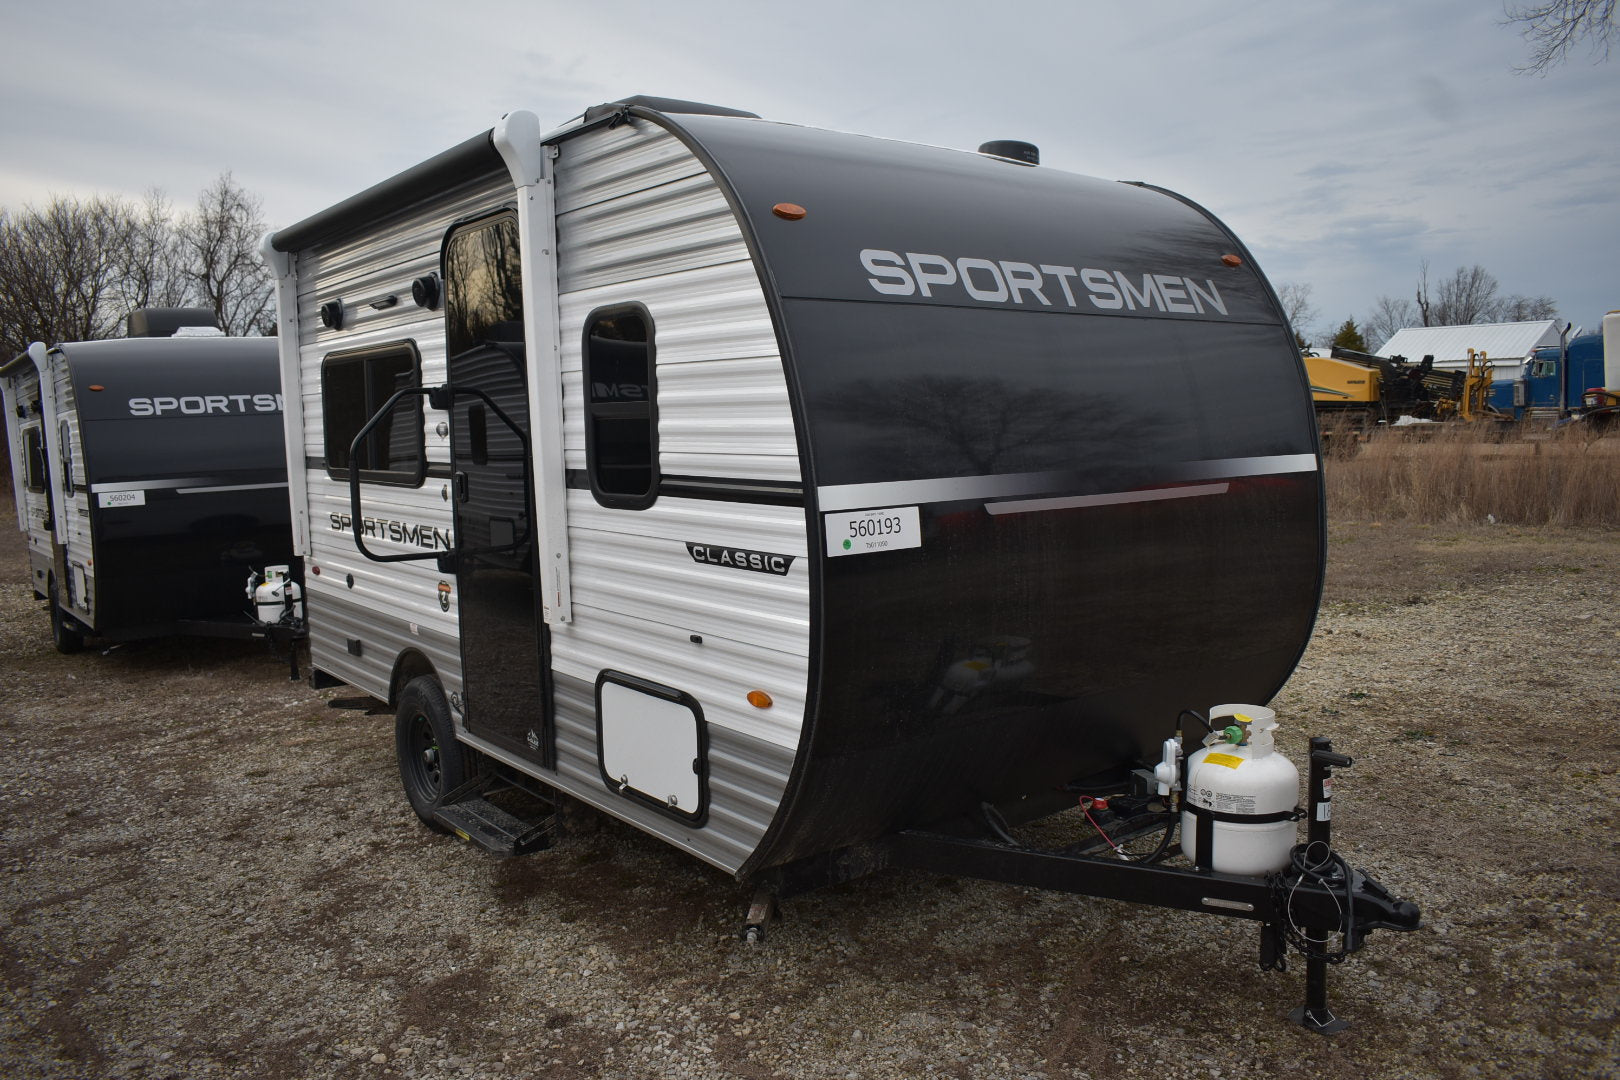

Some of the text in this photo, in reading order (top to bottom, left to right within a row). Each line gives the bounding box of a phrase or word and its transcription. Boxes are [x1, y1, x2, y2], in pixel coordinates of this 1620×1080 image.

[859, 248, 1229, 316] SPORTSMEN
[329, 511, 451, 550] SPRTSMEN
[849, 516, 901, 538] 560193
[692, 545, 786, 573] CLASSIC
